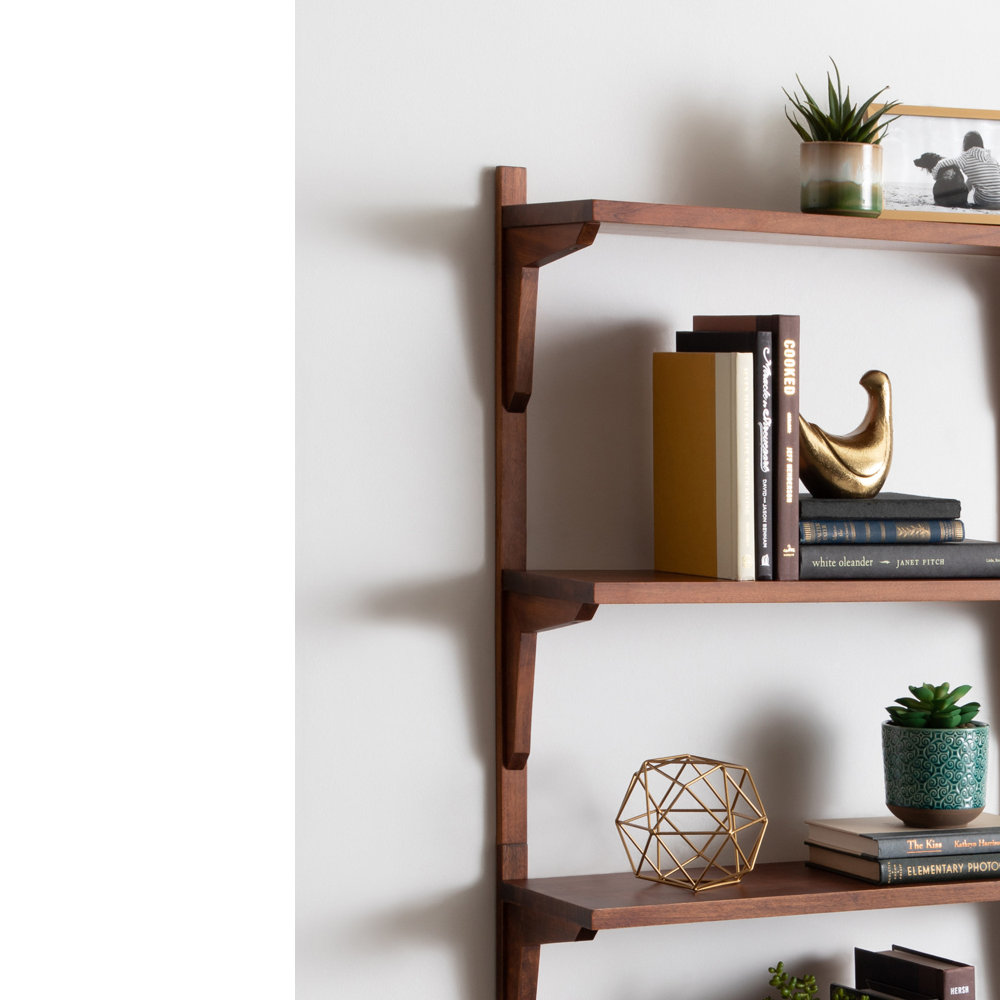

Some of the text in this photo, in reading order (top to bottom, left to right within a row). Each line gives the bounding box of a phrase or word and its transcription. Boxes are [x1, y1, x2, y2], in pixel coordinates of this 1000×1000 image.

[783, 339, 796, 396] COOKED
[812, 556, 837, 568] white
[838, 556, 874, 568] oleander
[896, 559, 919, 569] JANET
[922, 558, 945, 566] FITCH
[906, 839, 923, 850] The
[925, 838, 942, 849] Kiss
[953, 839, 977, 848] Kathryn
[906, 863, 964, 877] ELEMENTARY
[950, 985, 970, 995] HERSH
